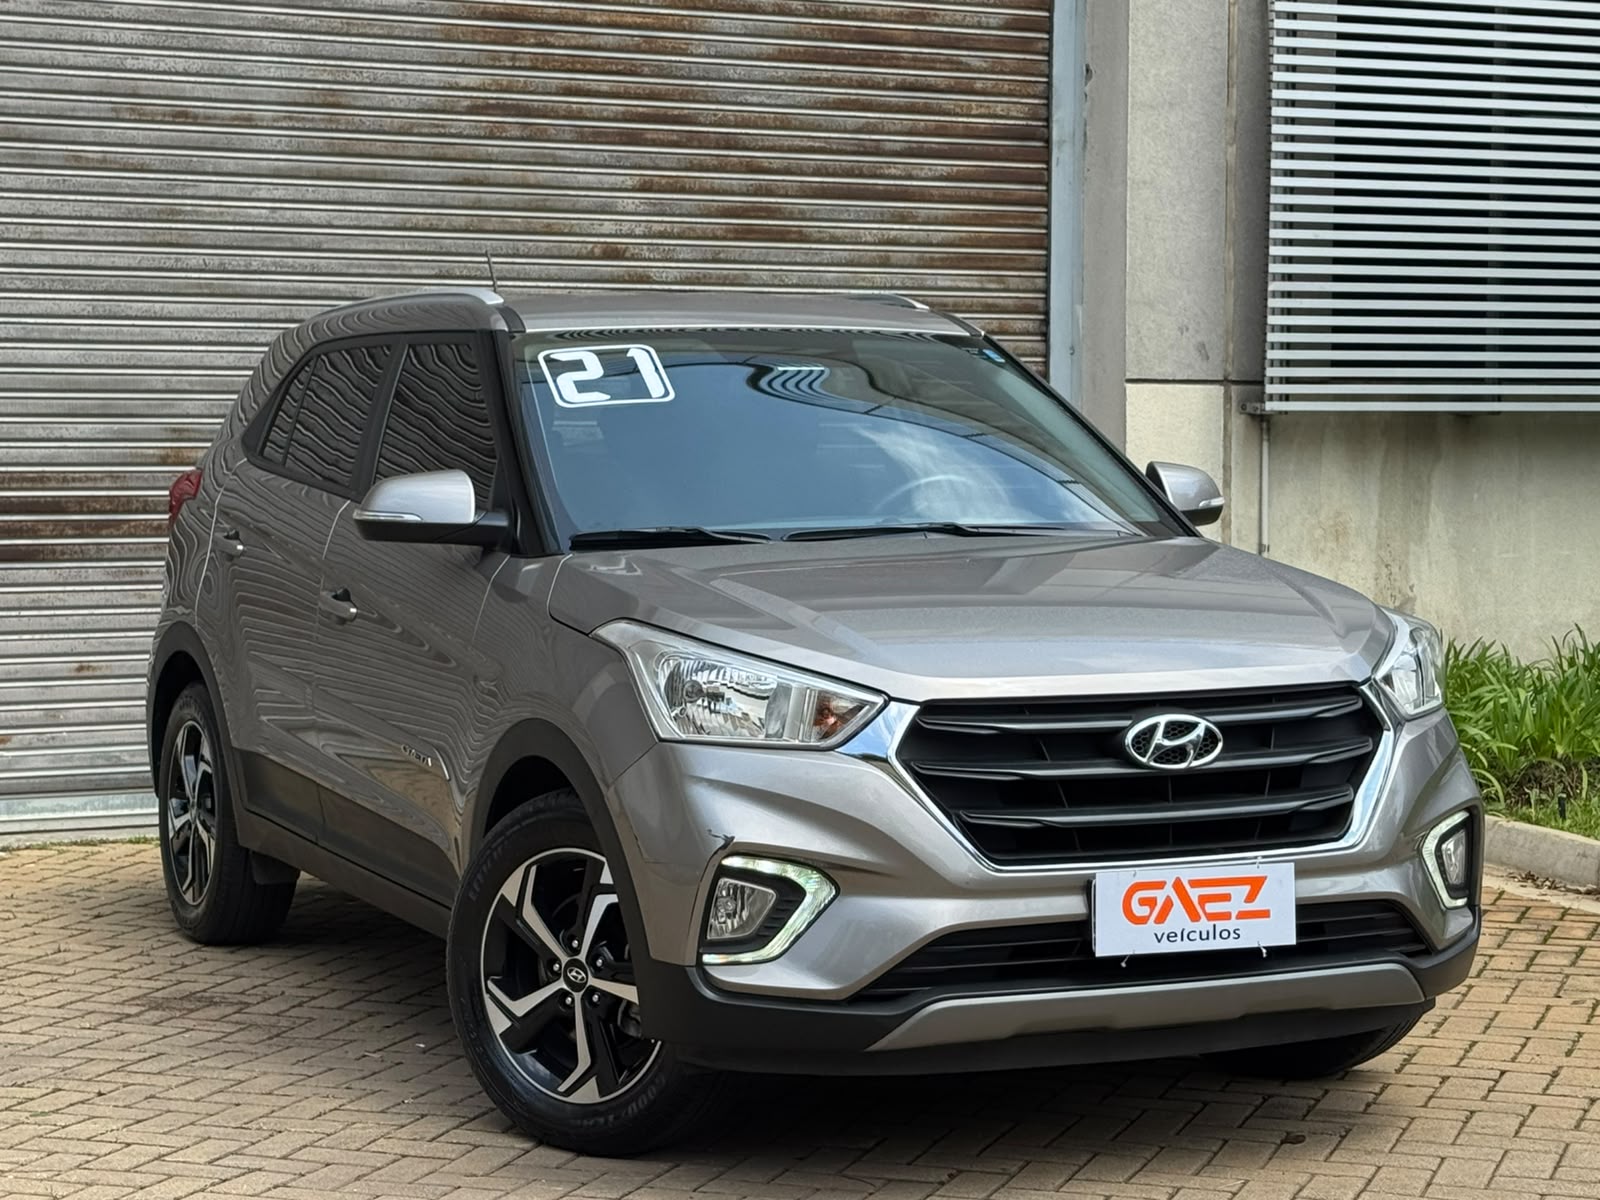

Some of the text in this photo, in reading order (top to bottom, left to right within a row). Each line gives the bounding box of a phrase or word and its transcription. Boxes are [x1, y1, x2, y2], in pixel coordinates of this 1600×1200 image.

[549, 346, 666, 402] 21
[1122, 875, 1271, 925] GAEZ
[1154, 923, 1241, 944] veículos
